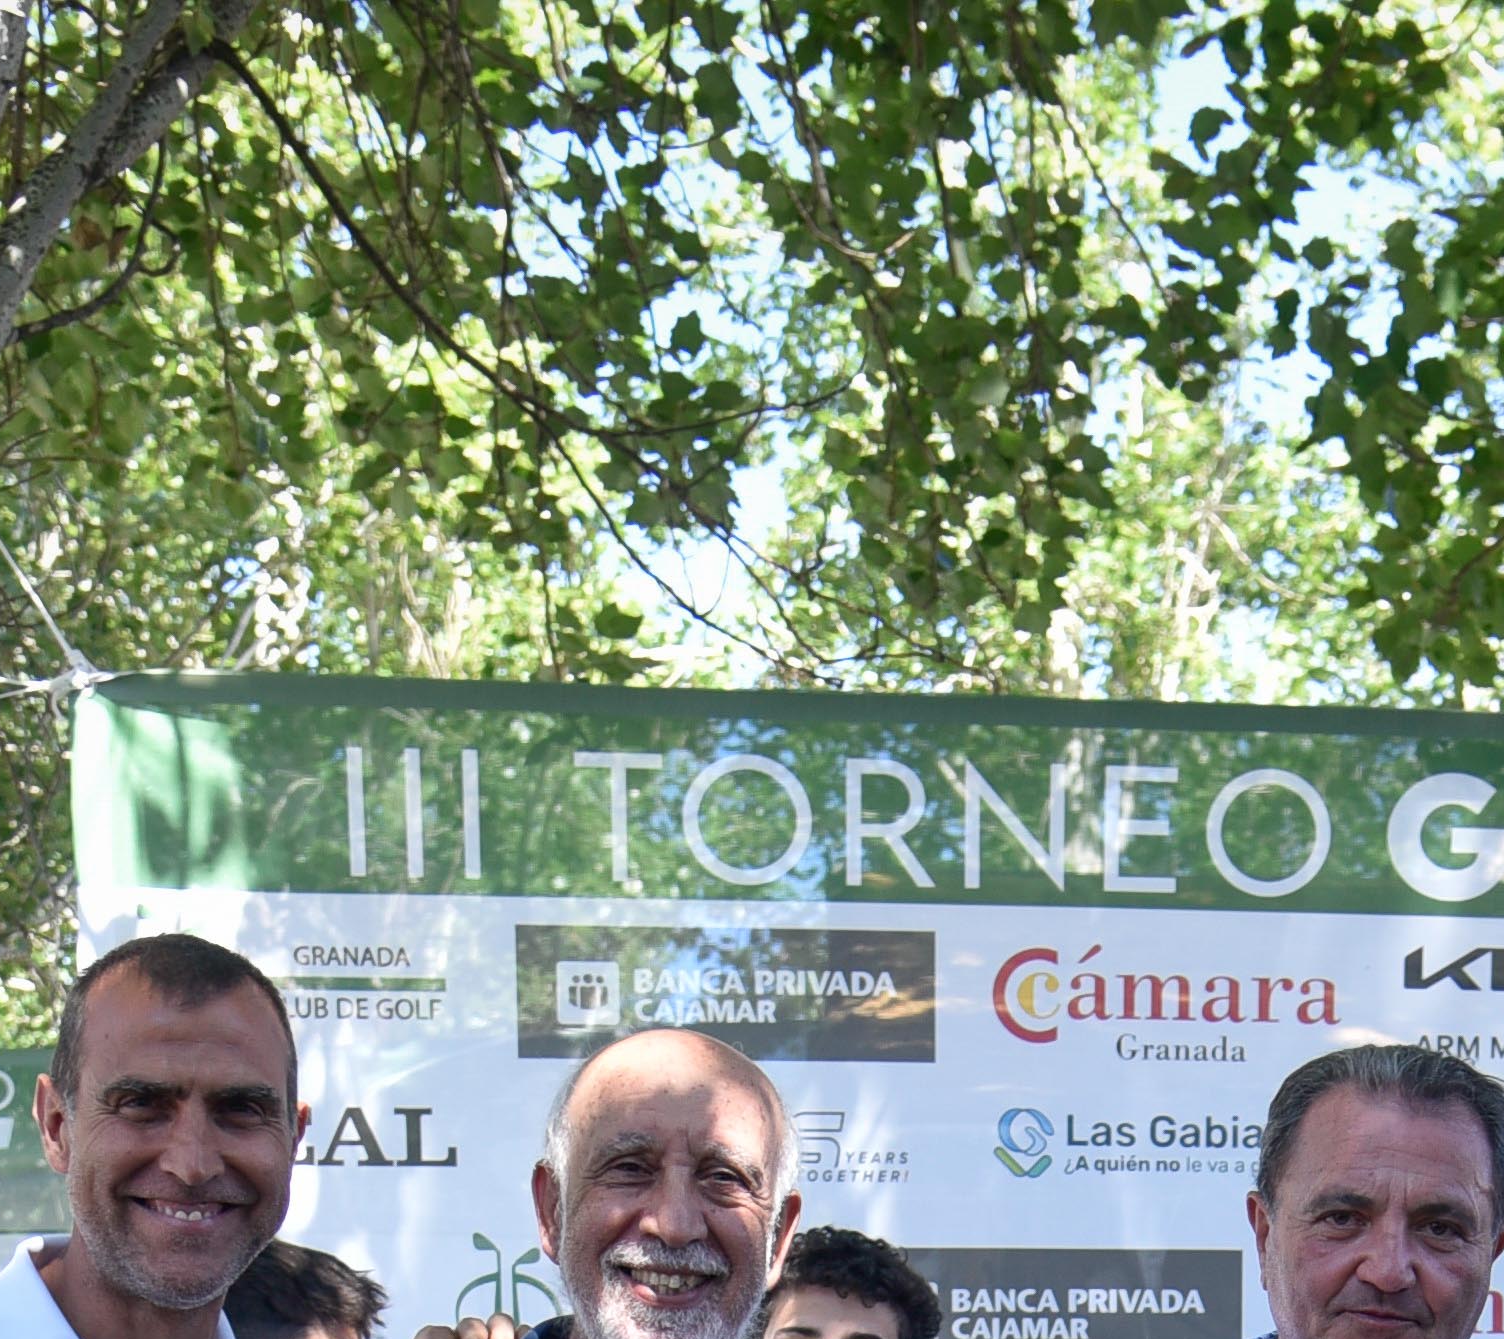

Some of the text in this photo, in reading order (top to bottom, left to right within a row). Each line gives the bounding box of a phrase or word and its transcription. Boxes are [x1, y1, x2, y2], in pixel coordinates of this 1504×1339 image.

[346, 746, 481, 880] III
[574, 752, 1332, 897] TORNEO
[293, 945, 411, 968] GRANADA
[634, 968, 896, 998] BANCA PRIVADA
[285, 996, 441, 1020] LUB DE GOLF
[634, 999, 777, 1026] CAJAMAR
[1116, 1033, 1247, 1062] Granada
[1067, 1114, 1263, 1148] Las Gabia
[846, 1152, 909, 1164] YEARS
[1094, 1156, 1150, 1175] quién
[1156, 1159, 1180, 1172] no
[1186, 1157, 1202, 1172] le
[1208, 1160, 1229, 1173] va
[1234, 1160, 1245, 1173] a
[807, 1169, 909, 1183] OGETHER!
[951, 1288, 1206, 1315] BANCA PRIVADA
